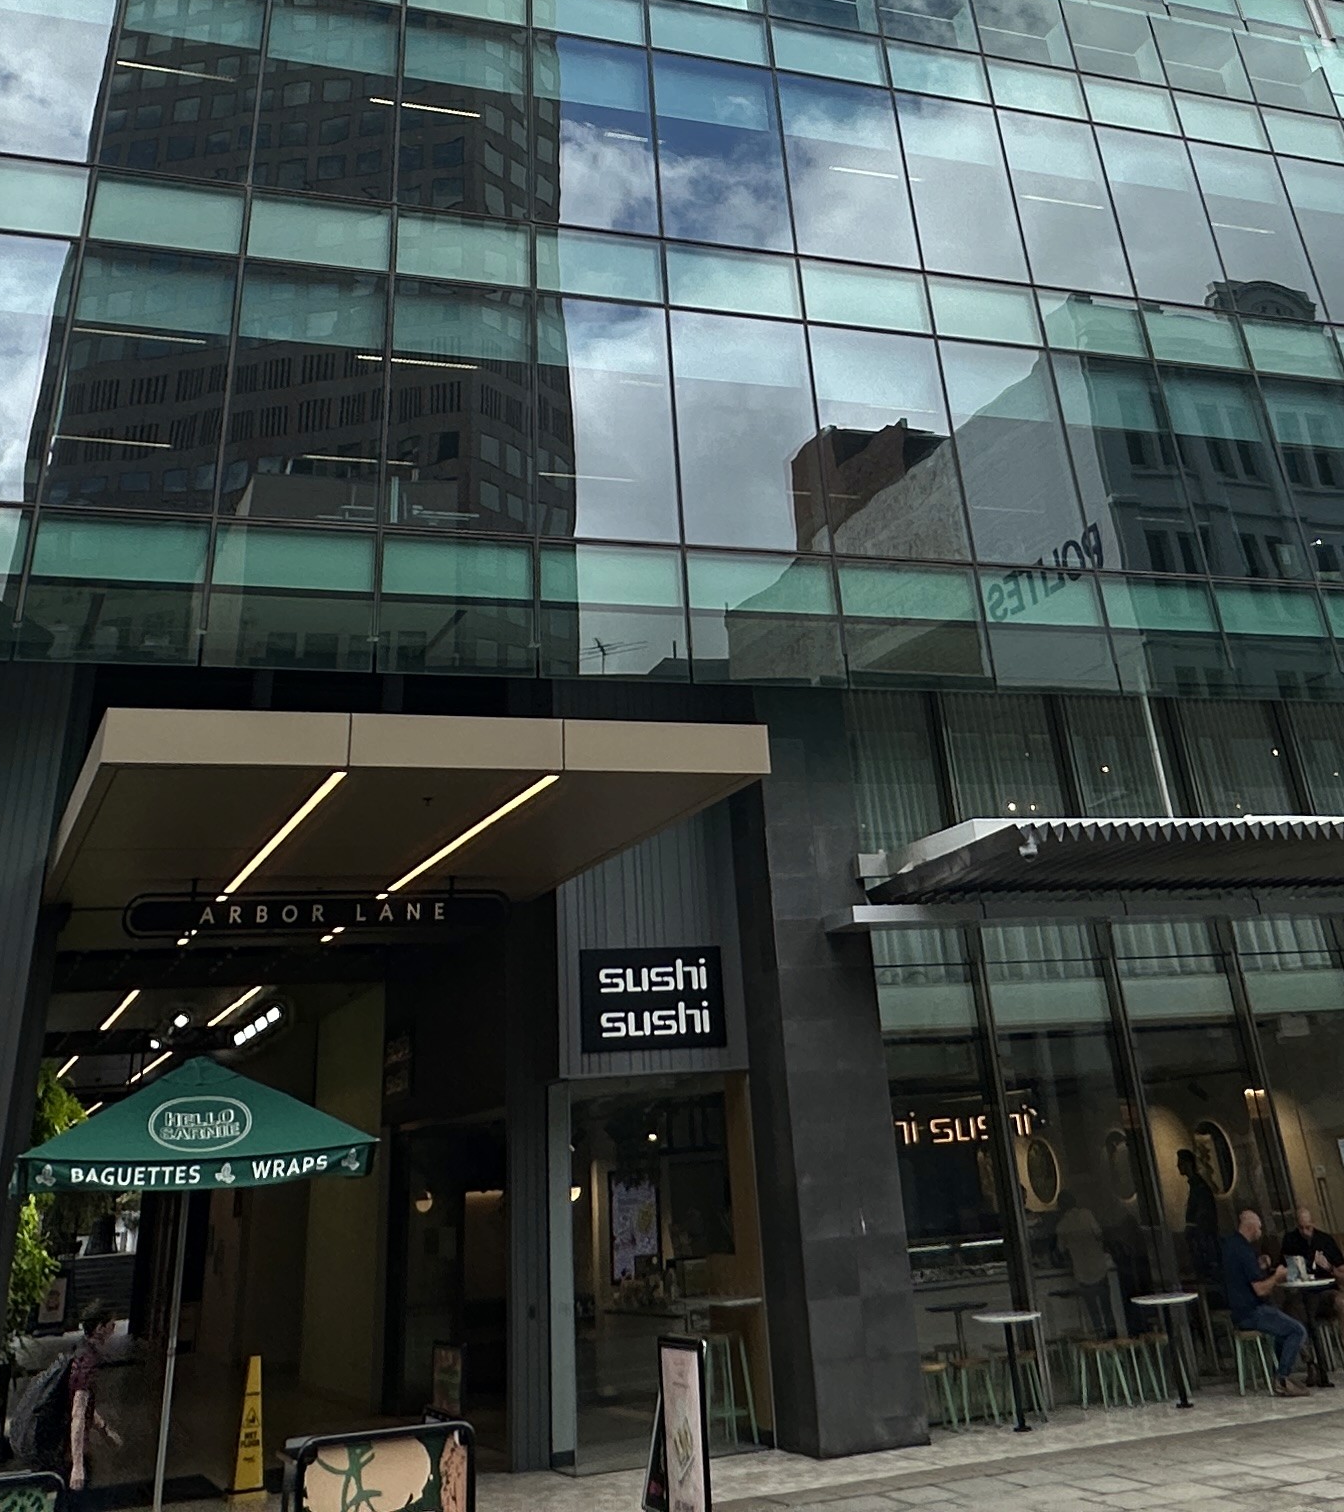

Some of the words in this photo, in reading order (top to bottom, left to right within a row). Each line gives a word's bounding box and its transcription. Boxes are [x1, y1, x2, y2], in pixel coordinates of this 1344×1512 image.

[199, 904, 325, 925] ARBOR
[355, 902, 446, 922] LANE
[599, 958, 707, 993] sushi
[600, 1000, 710, 1038] sushi
[159, 1121, 240, 1140] SARNIE
[164, 1108, 235, 1128] HELLO
[71, 1165, 201, 1186] BAGUETTES
[251, 1155, 328, 1179] WRAPS
